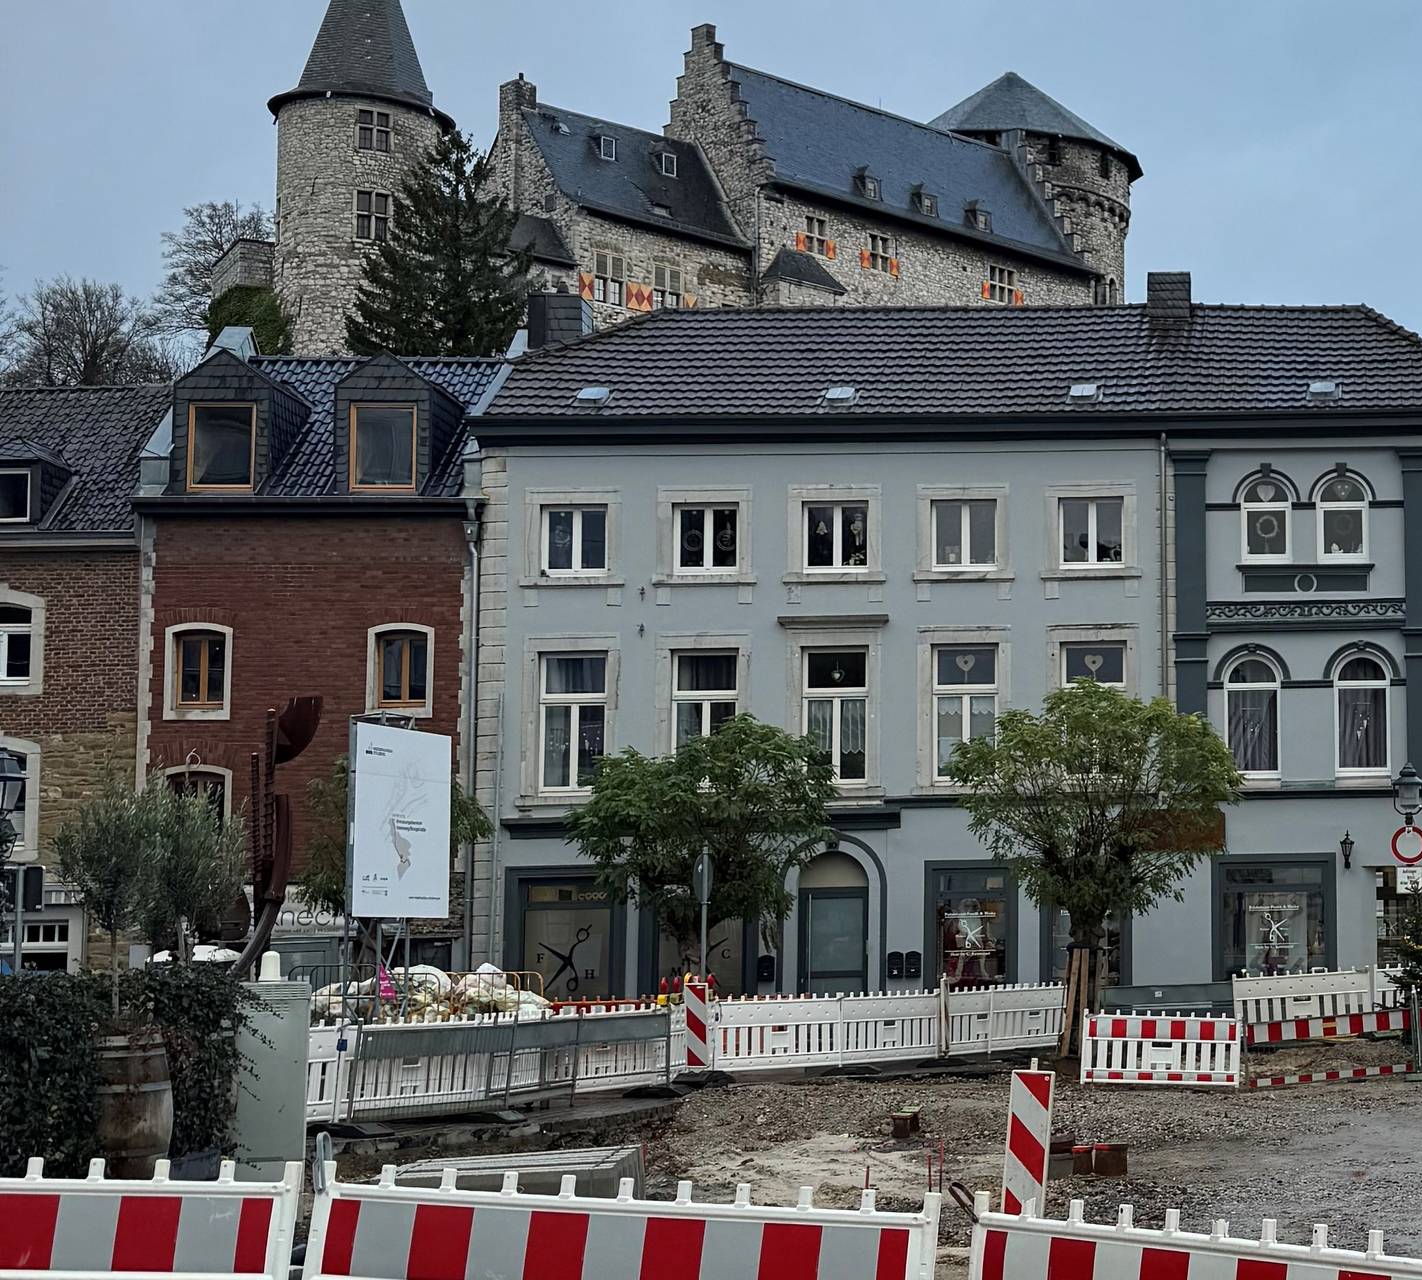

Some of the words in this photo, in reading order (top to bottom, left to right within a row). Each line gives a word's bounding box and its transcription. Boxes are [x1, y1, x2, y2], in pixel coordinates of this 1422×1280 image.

[536, 953, 544, 963] F
[721, 949, 730, 960] C
[584, 969, 594, 980] H
